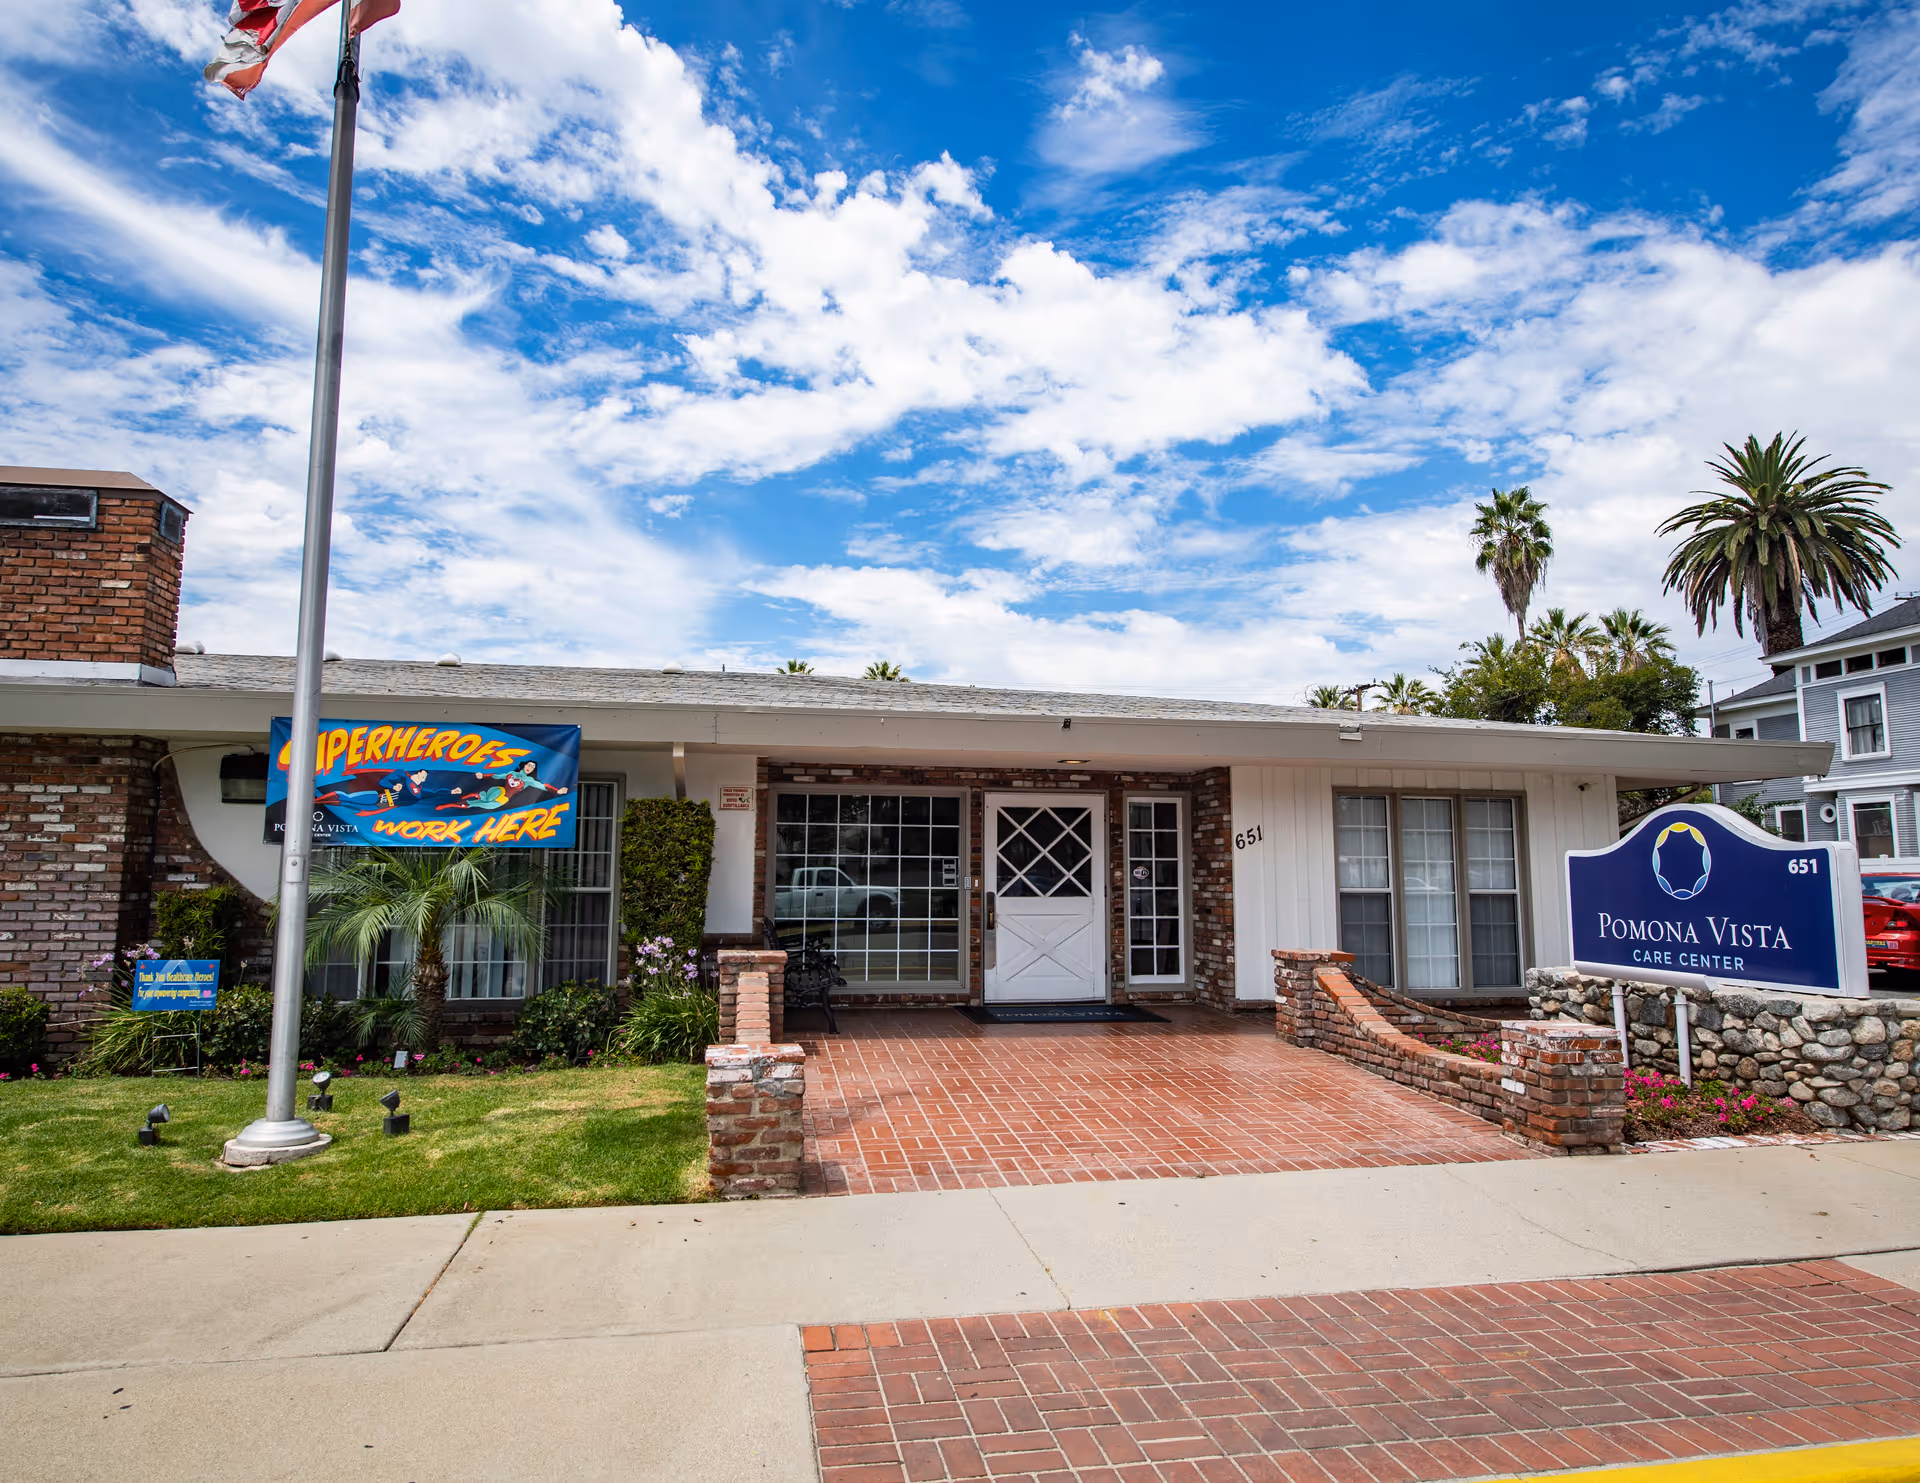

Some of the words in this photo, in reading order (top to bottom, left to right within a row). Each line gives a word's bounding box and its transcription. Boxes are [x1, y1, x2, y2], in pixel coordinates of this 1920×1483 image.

[274, 823, 324, 832] PONA
[328, 824, 359, 832] VISTA
[371, 818, 471, 844] WORK
[472, 802, 570, 844] HERE
[1235, 824, 1263, 850] 651
[1788, 858, 1818, 874] 651
[1633, 949, 1672, 964] CARE
[1679, 952, 1744, 971] CENTER
[139, 972, 154, 982] Thank
[156, 972, 166, 982] You
[166, 972, 194, 982] Healthcare
